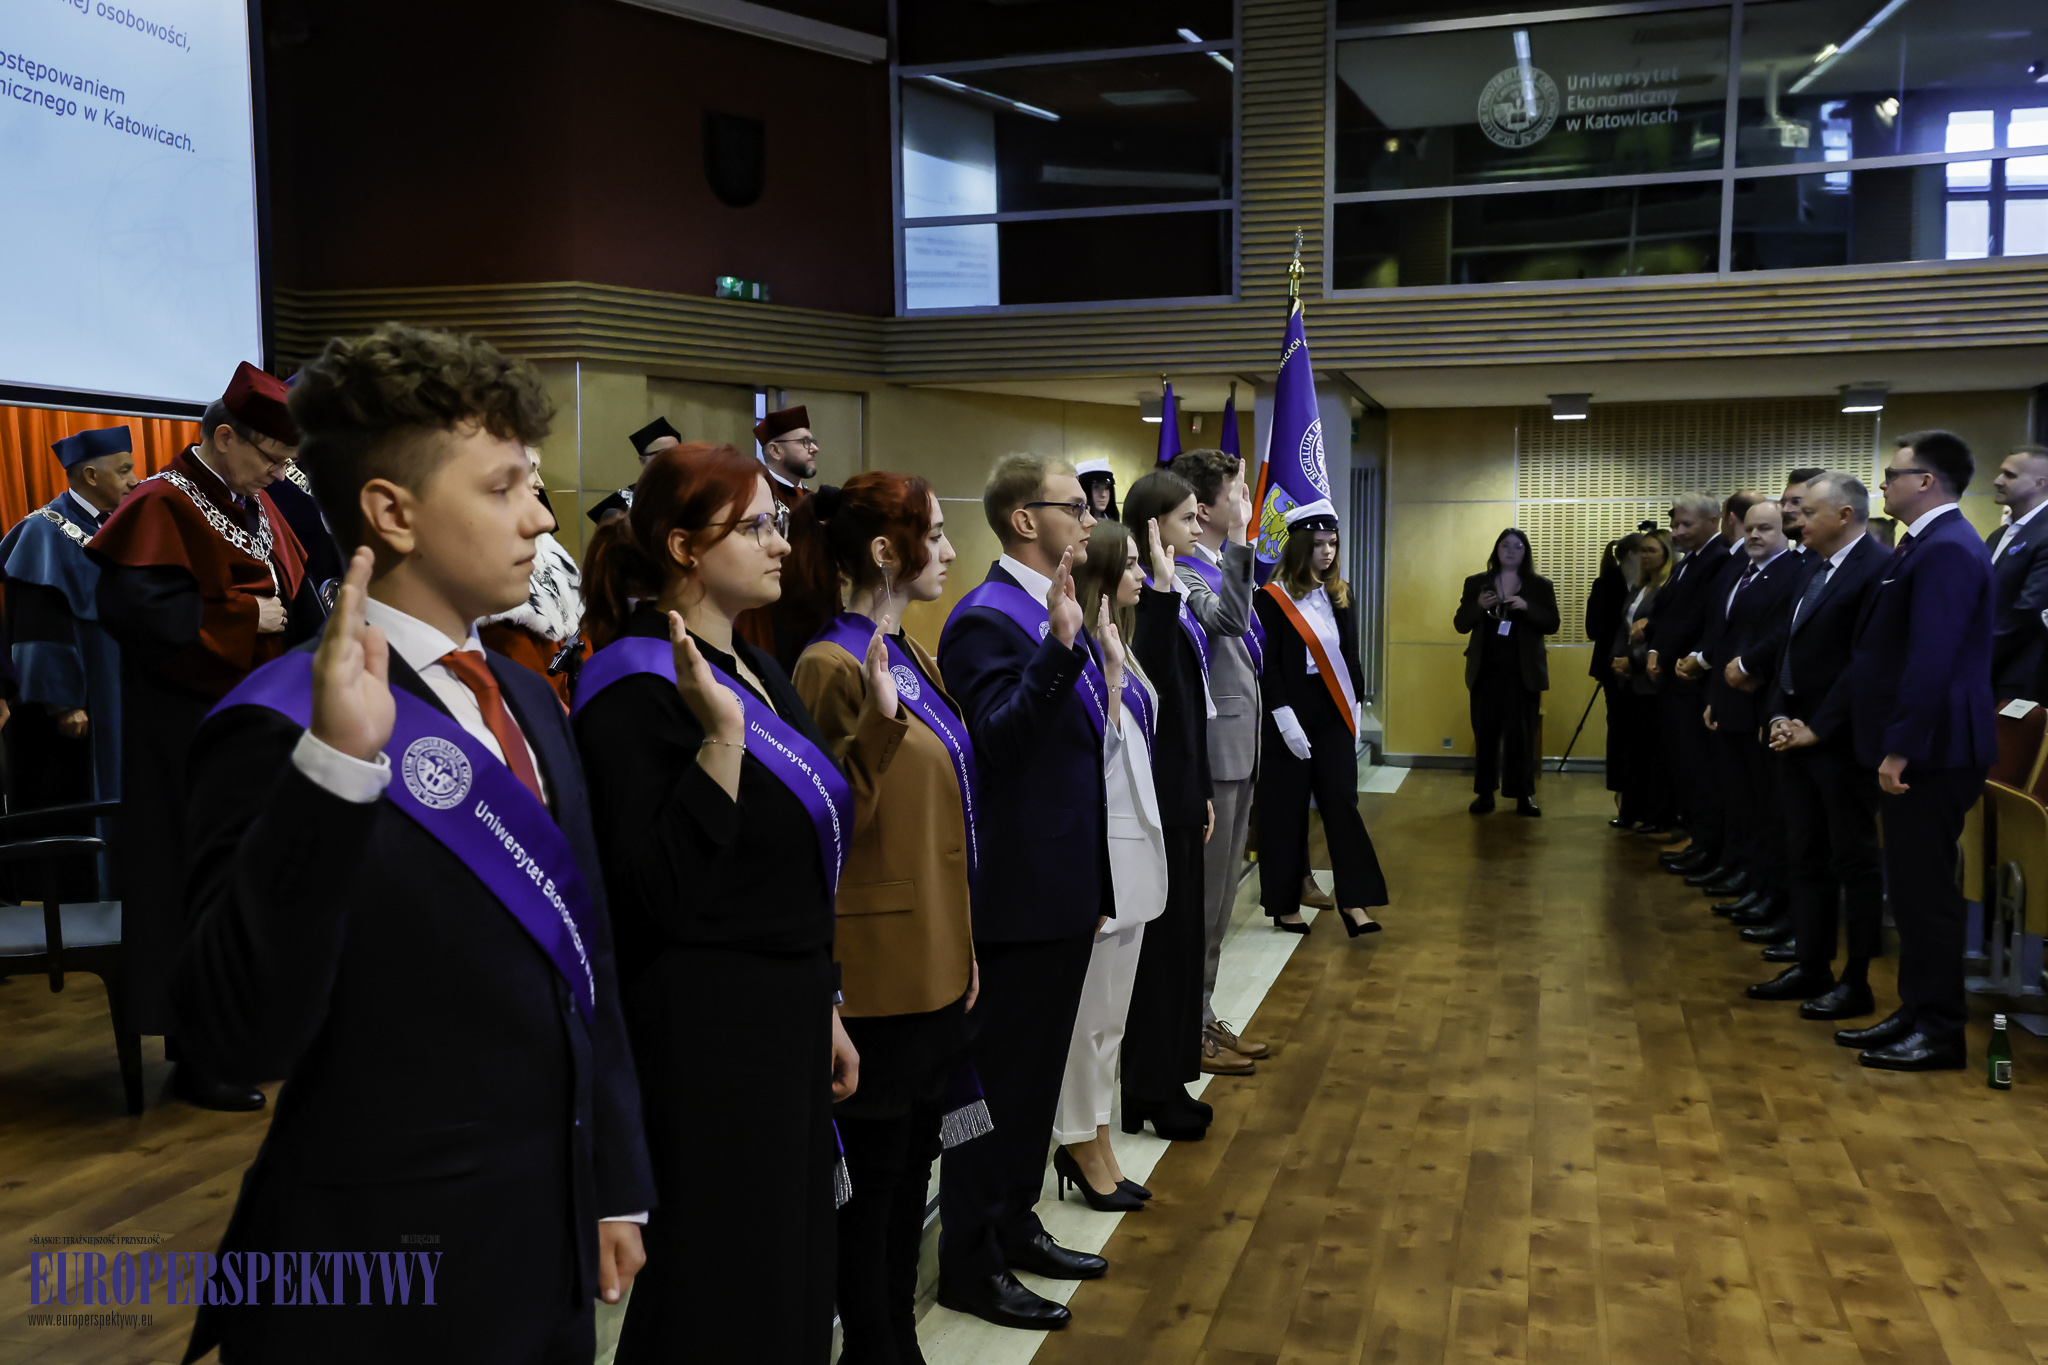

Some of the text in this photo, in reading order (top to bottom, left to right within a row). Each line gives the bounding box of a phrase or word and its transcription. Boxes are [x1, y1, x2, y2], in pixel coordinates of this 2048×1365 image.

[96, 2, 191, 53] osobowości,
[1567, 65, 1680, 92] Uniwersytet
[1566, 88, 1679, 112] Ekonomiczny
[1566, 107, 1679, 132] w Katowicach
[84, 105, 98, 122] w
[103, 108, 196, 153] Katowicach.
[1278, 337, 1302, 374] WICACH
[750, 720, 812, 777] Uniwersytet
[474, 799, 545, 887] Uniwersytet
